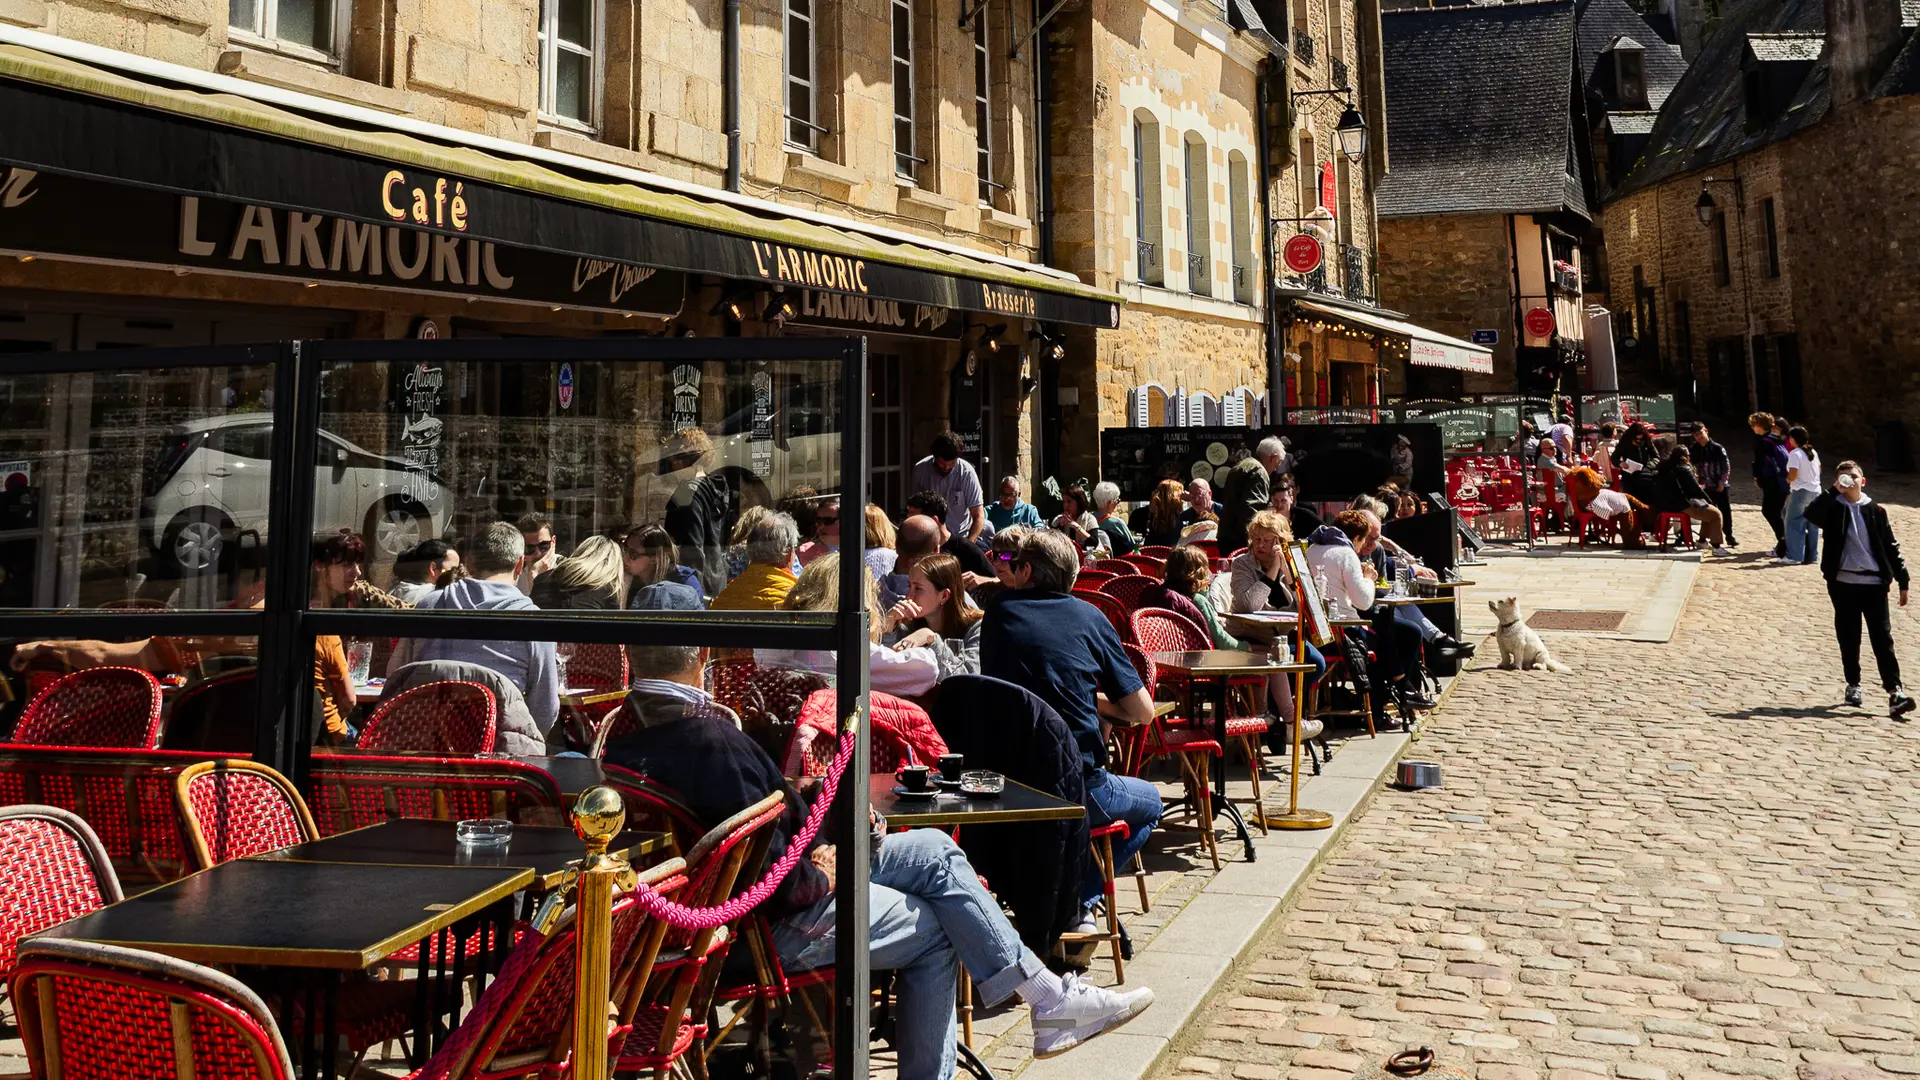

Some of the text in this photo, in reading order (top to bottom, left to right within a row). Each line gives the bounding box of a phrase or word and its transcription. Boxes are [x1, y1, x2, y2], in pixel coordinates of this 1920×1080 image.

[382, 170, 468, 231] Café
[178, 196, 514, 289] LARMORIC
[752, 240, 868, 294] L'ARMORIC
[802, 288, 906, 327] LARMORIC
[983, 283, 1035, 315] Brasserie
[405, 364, 444, 394] Always
[672, 364, 701, 389] KEEP CALM
[412, 391, 436, 420] FRESH
[675, 395, 697, 413] DRINK
[1310, 412, 1330, 420] MAISON
[1342, 412, 1371, 420] TRADITION
[1429, 410, 1451, 419] MAISON
[1462, 409, 1493, 418] CONFIANCE
[404, 445, 438, 468] Try a
